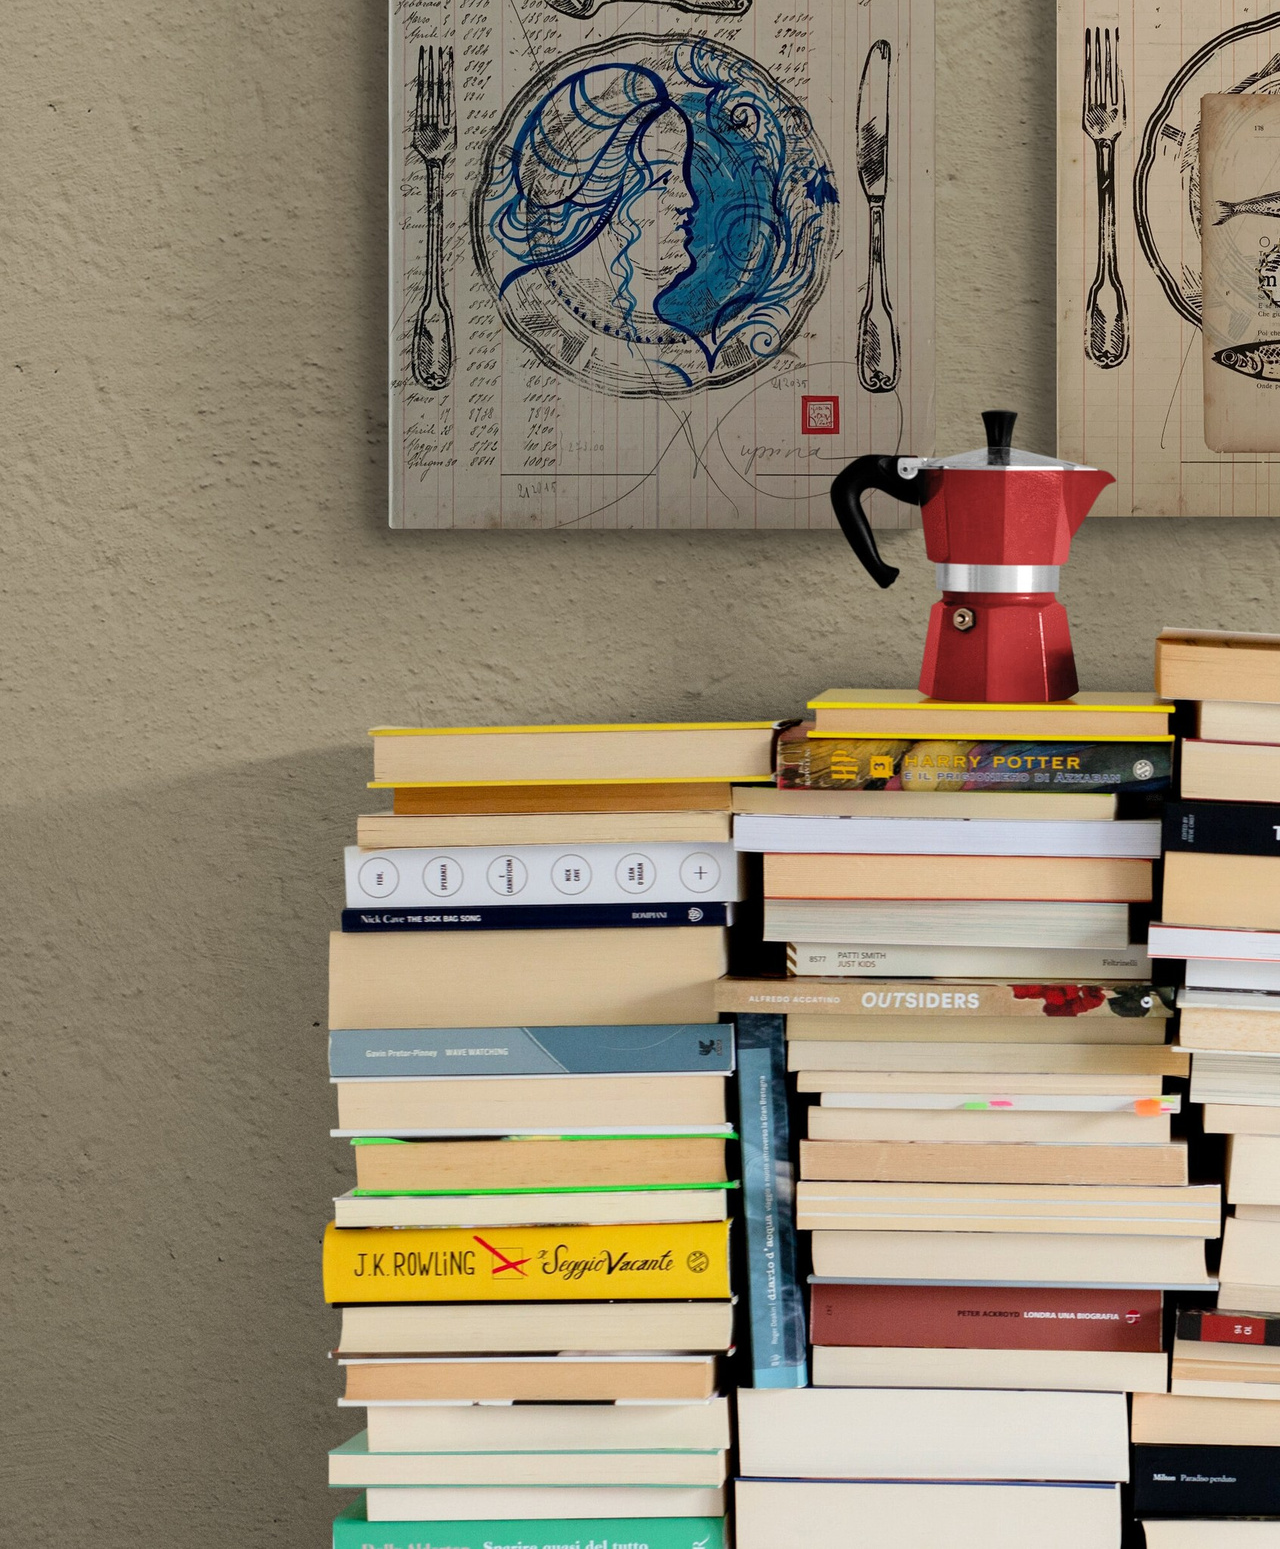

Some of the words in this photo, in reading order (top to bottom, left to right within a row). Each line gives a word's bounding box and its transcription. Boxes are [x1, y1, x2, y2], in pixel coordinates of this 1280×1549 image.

[904, 755, 981, 768] HARRY
[993, 756, 1080, 769] POTTER
[904, 772, 912, 780] E
[918, 772, 930, 780] IL
[937, 772, 1029, 782] PRIGIONIERO
[1035, 773, 1049, 782] DI
[360, 915, 381, 923] Nick
[383, 915, 405, 923] Cave
[809, 955, 826, 964] 8577
[837, 952, 859, 960] PATTI
[860, 951, 886, 960] SMITH
[837, 960, 855, 969] JUST
[857, 960, 876, 968] KIDS
[1102, 959, 1138, 967] Feltrinelli
[749, 995, 790, 1003] ALFREDO
[793, 996, 841, 1004] ACCATINO
[861, 992, 979, 1009] OUTSIDERS
[470, 1048, 508, 1056] WATCHING
[542, 1244, 607, 1280] Seggio
[600, 1250, 675, 1275] Vacante
[766, 1262, 776, 1300] diario
[957, 1309, 980, 1317] PETER
[982, 1310, 1020, 1318] ACKROYD
[1024, 1311, 1055, 1319] LONDRA
[1058, 1311, 1075, 1320] UNA
[1076, 1312, 1119, 1321] BIOGRAFIA
[1153, 1473, 1176, 1481] Milton
[1180, 1473, 1208, 1482] Paradiso
[1209, 1474, 1236, 1484] perduto
